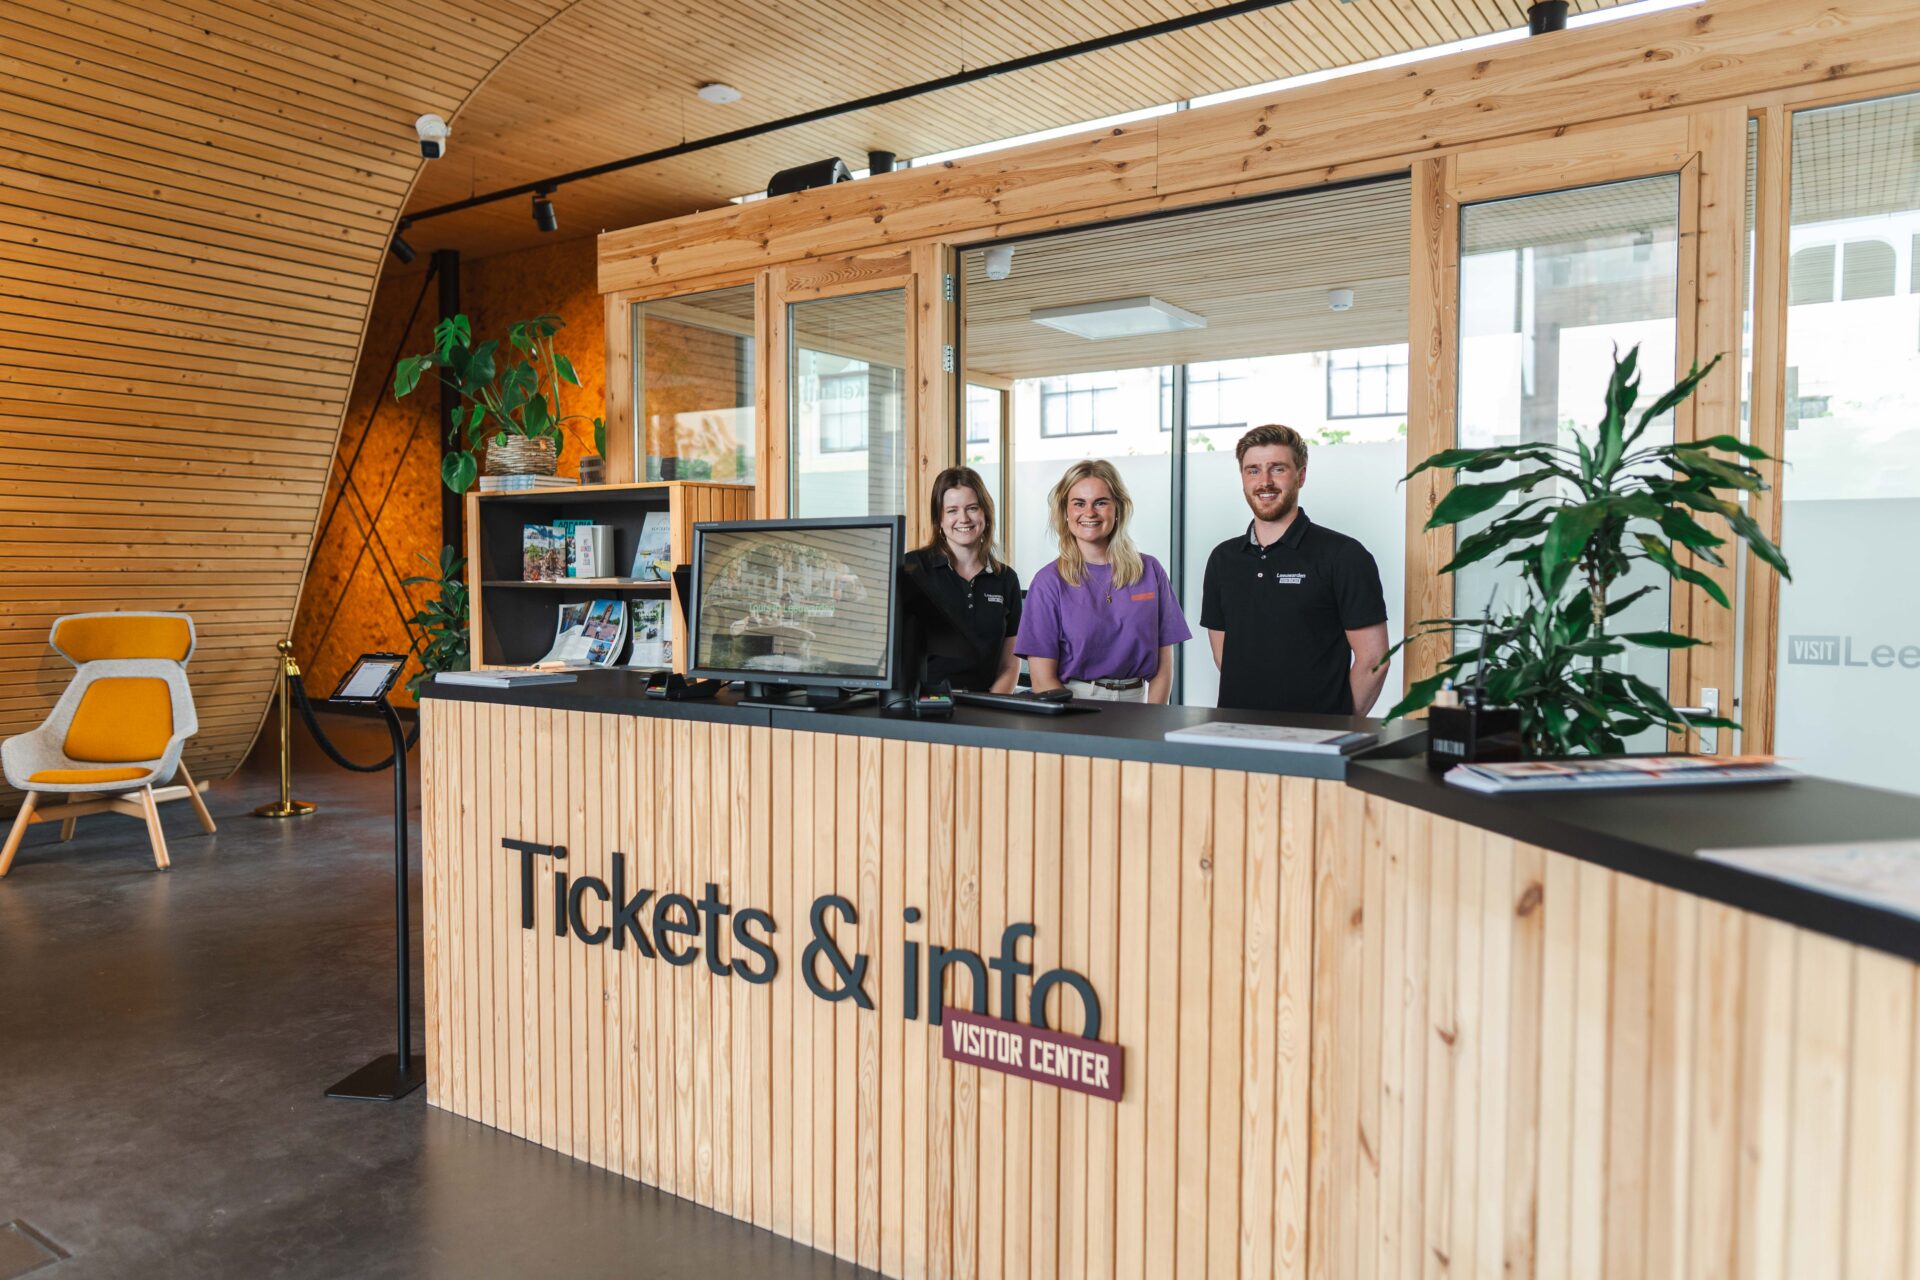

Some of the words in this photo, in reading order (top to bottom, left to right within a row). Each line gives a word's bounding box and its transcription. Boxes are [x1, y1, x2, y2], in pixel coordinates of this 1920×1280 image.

[1793, 640, 1835, 661] VISIT
[1844, 636, 1920, 669] Lee
[501, 837, 779, 985] Tickets
[801, 893, 875, 1010] &
[902, 906, 1101, 1042] info
[951, 1019, 1024, 1068] VISITOR
[1029, 1037, 1110, 1090] CENTER
